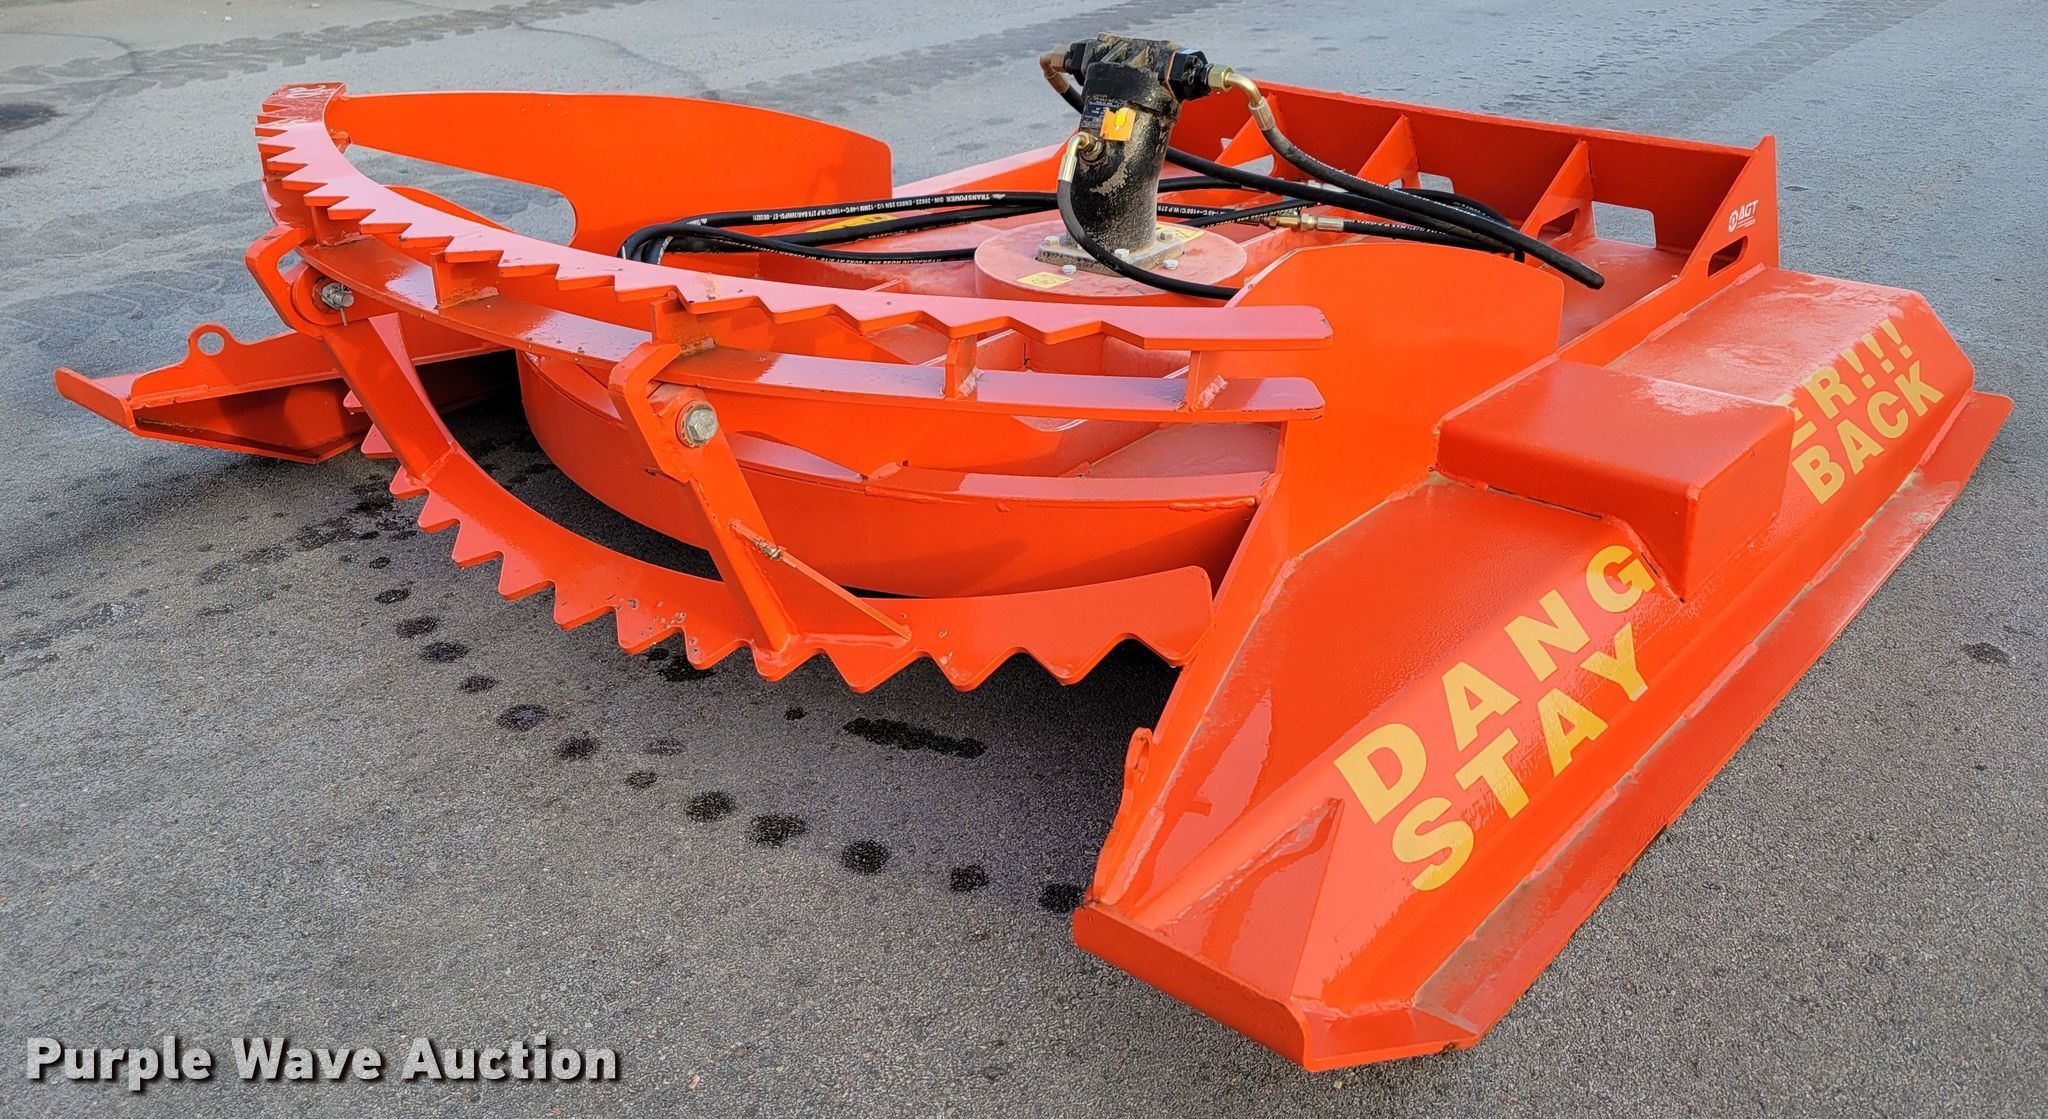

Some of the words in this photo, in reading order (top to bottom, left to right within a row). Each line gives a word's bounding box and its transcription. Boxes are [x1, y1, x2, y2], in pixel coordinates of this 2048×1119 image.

[946, 194, 990, 202] TRANSPOWER
[1739, 199, 1759, 221] AGT
[1392, 622, 1648, 891] STAY
[1792, 360, 1944, 504] BACK
